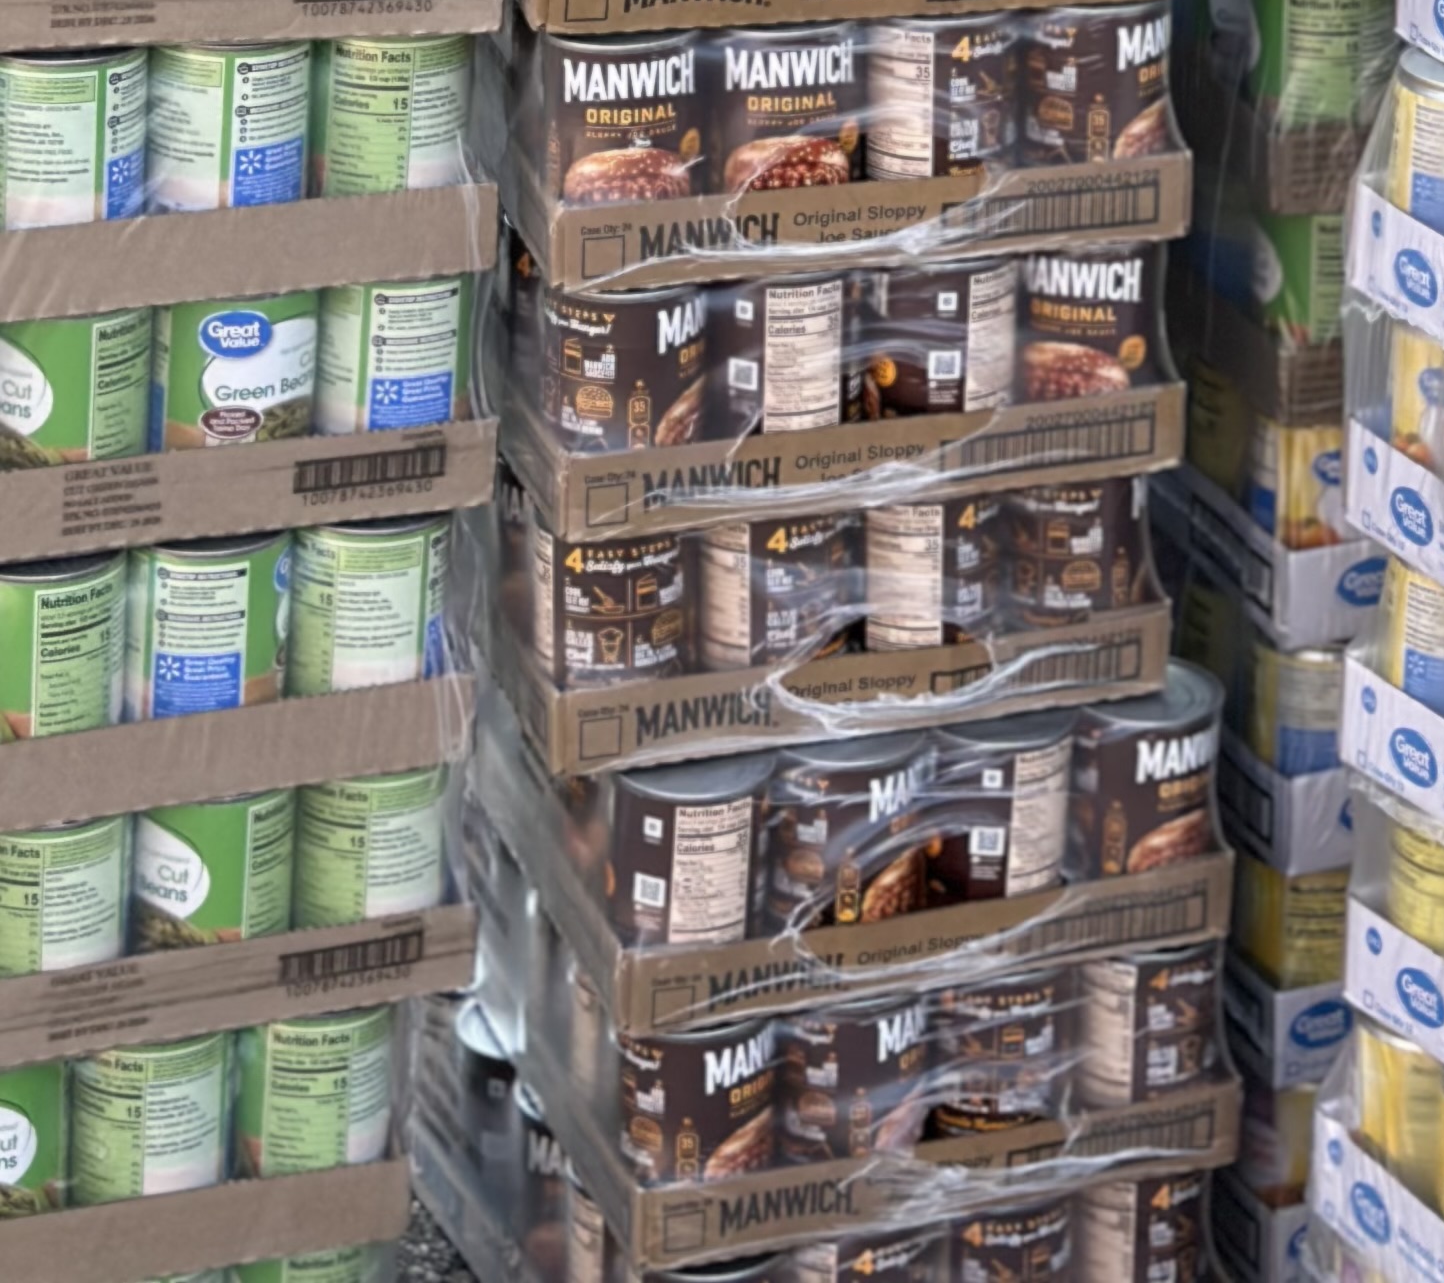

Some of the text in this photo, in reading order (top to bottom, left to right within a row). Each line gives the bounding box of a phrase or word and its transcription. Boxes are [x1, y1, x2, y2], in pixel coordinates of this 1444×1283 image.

[303, 1, 433, 17] 10078742369430
[725, 42, 853, 90] MANWICH
[564, 52, 695, 102] MANWICH
[393, 98, 408, 110] 15
[748, 92, 836, 111] ORIGINAL
[586, 104, 677, 124] ORIGINAL
[792, 202, 926, 225] Original Sloppy
[208, 322, 260, 340] Great
[220, 335, 260, 347] Value
[2, 381, 32, 401] Cut
[215, 384, 276, 402] Green
[303, 481, 433, 506] 10078742369430
[857, 672, 916, 692] Sloppy
[635, 686, 773, 745] MANWICH
[157, 865, 190, 884] Cut
[856, 946, 923, 966] Original
[718, 1181, 856, 1233] MANWICH
